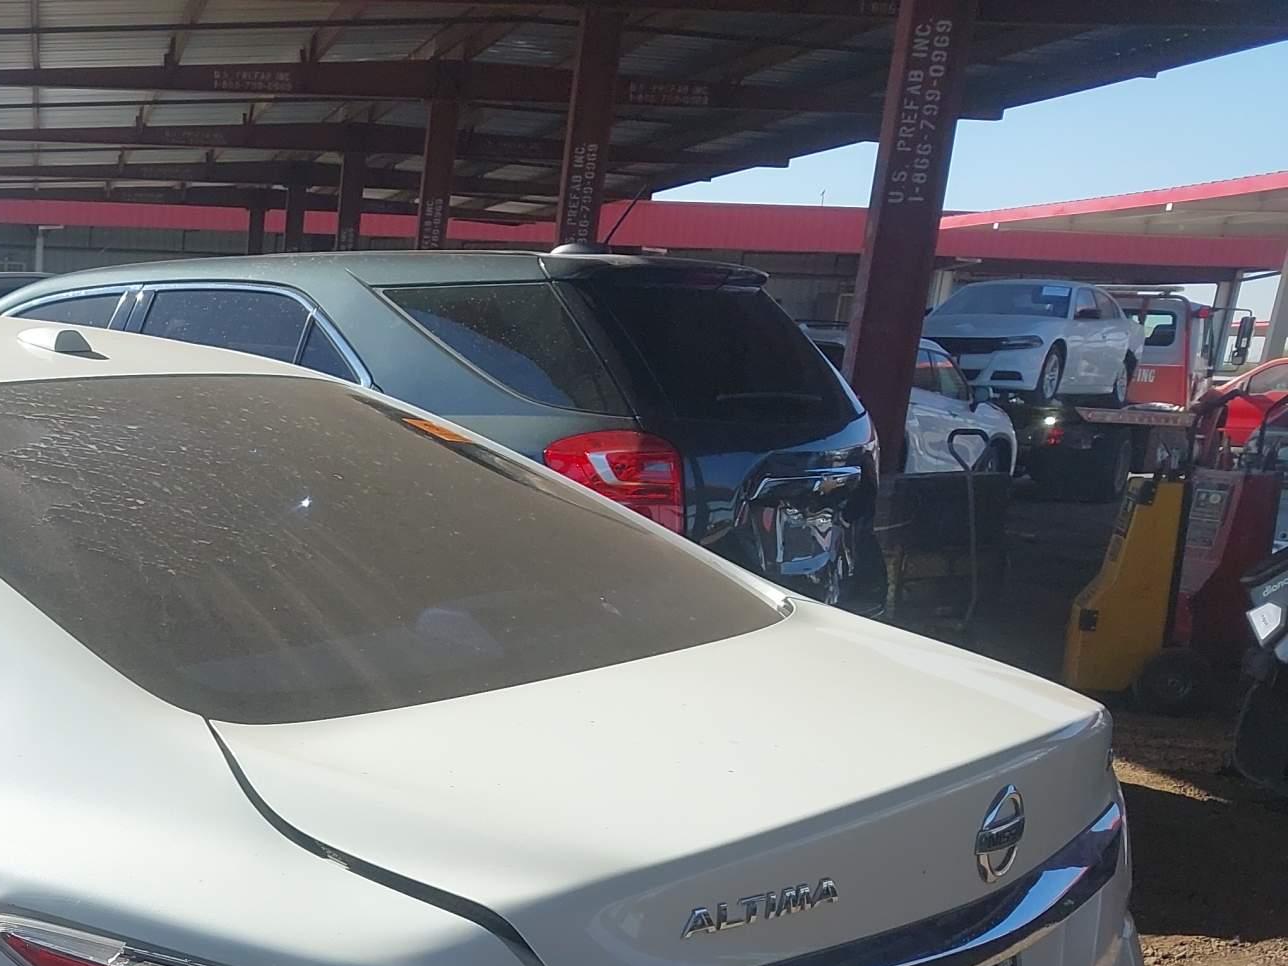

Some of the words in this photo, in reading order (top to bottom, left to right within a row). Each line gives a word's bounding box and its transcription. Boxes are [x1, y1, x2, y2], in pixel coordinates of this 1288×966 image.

[912, 18, 934, 59] INC.
[896, 69, 924, 152] PREFAB
[908, 19, 953, 202] 1-866-799-0969
[888, 164, 910, 204] U.S.
[681, 877, 839, 939] ALTIMA
